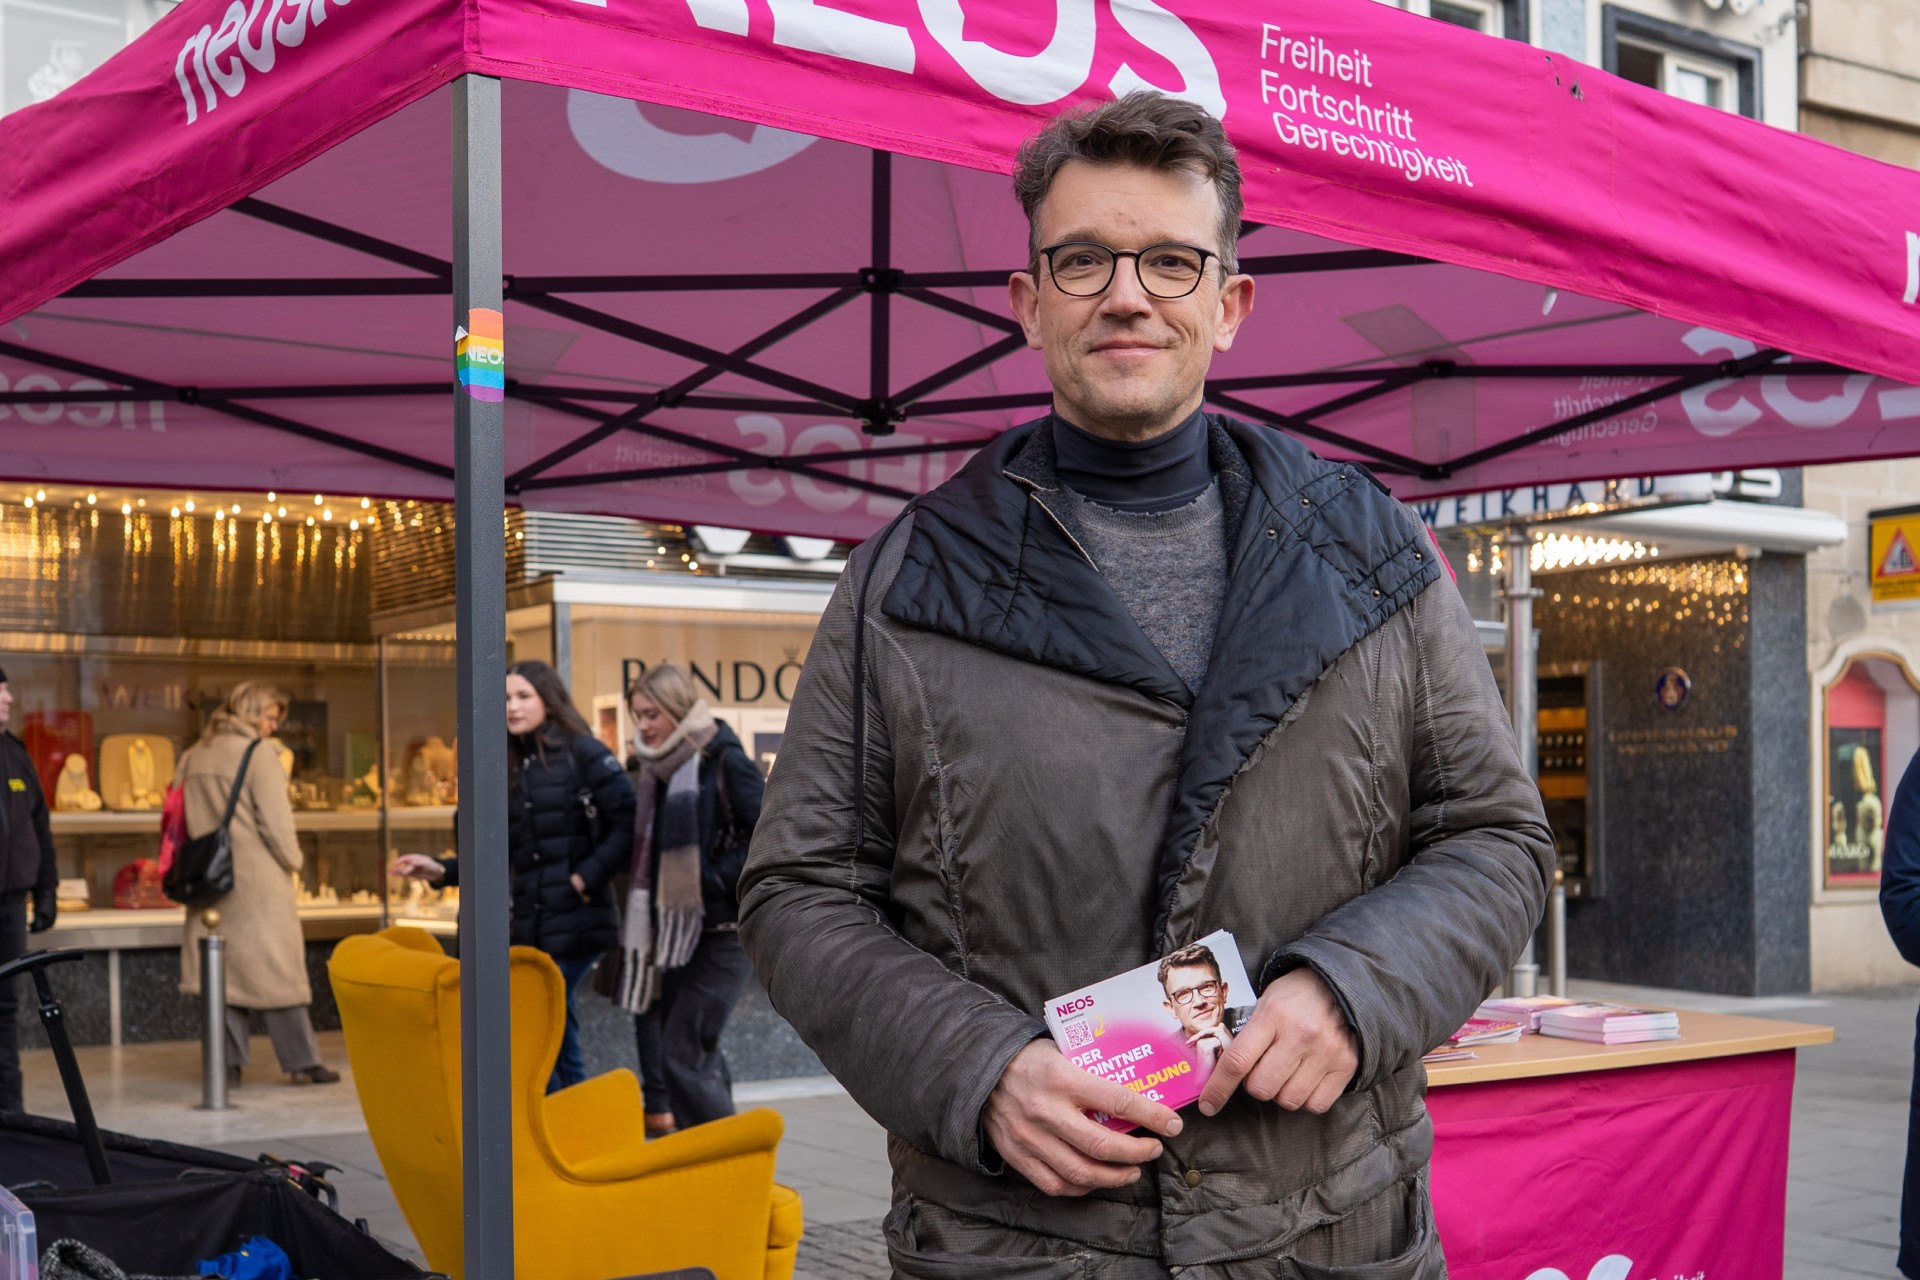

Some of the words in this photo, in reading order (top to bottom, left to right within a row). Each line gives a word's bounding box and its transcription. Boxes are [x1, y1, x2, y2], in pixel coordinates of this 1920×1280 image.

[1260, 22, 1373, 88] Freiheit
[1260, 68, 1417, 142] Fortschritt
[1272, 111, 1474, 188] Gerechtigkeit
[465, 344, 504, 366] NEO
[622, 658, 803, 703] PNDO
[1056, 995, 1095, 1018] NEOS
[1071, 1047, 1103, 1068] DER
[1086, 1043, 1155, 1076] OINTNER
